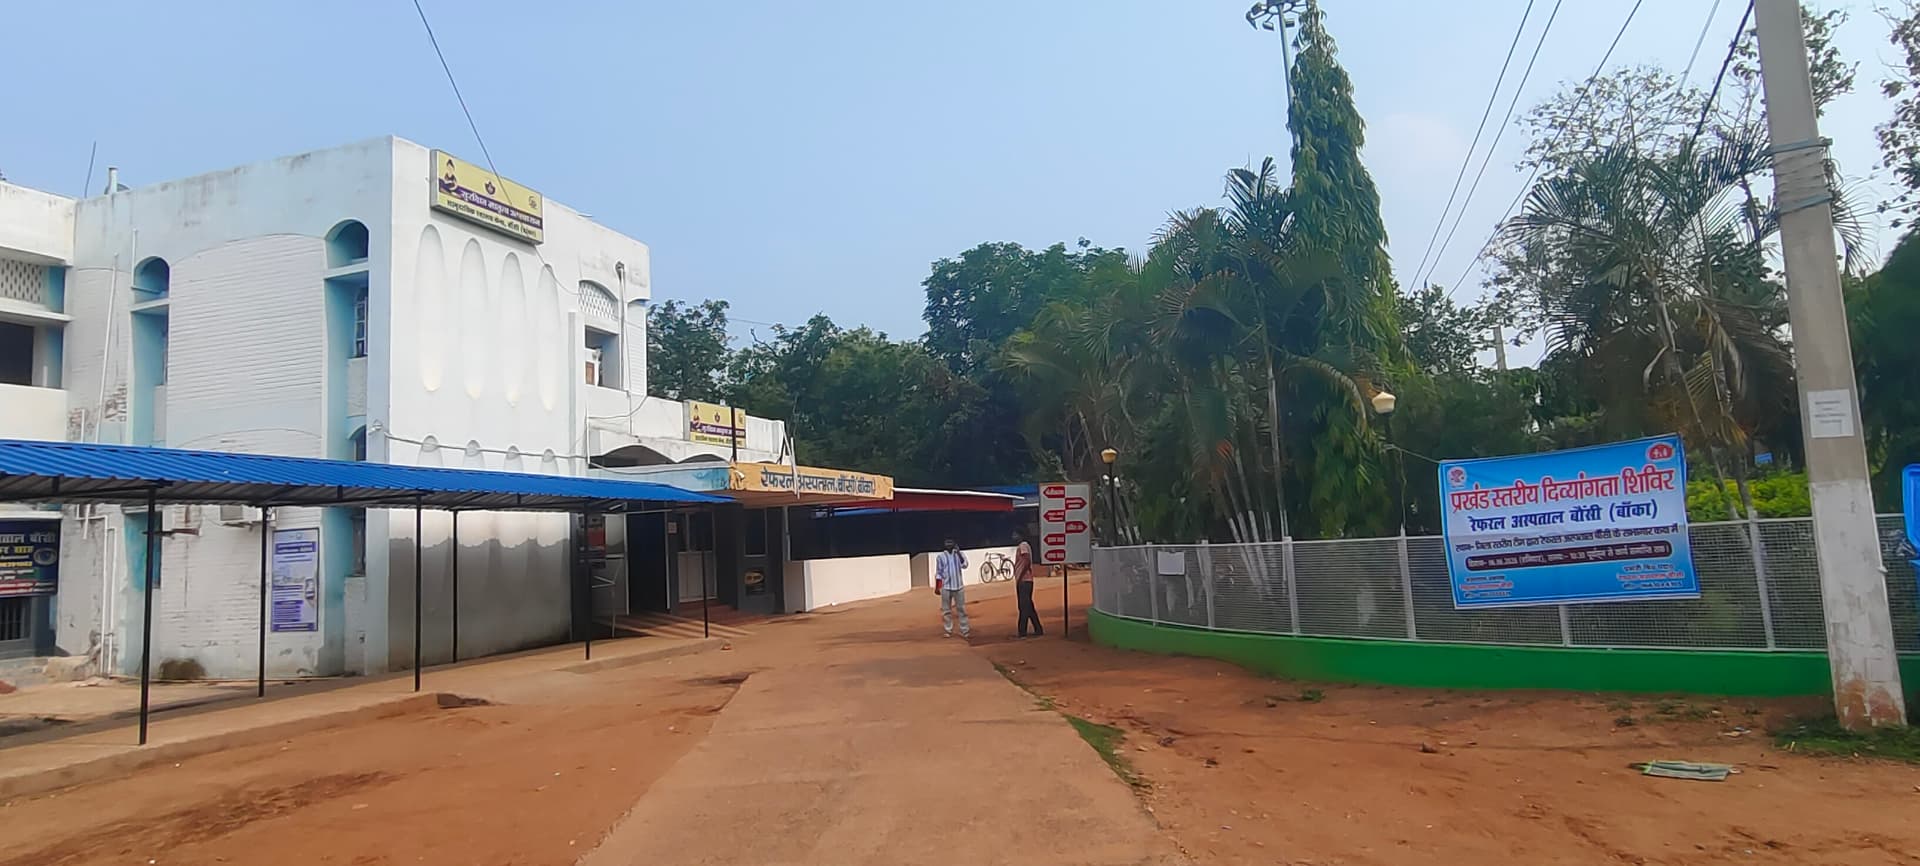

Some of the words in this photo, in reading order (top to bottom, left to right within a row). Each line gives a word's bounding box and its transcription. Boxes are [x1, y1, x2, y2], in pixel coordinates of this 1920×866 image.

[761, 465, 794, 488] रेफरल
[1450, 483, 1490, 513] प्रखंड
[1492, 479, 1540, 507] स्तरीय
[1542, 472, 1619, 504] दिव्यांगता
[1622, 464, 1674, 495] शिविर
[1467, 515, 1506, 531] रेफरल
[1511, 510, 1565, 528] अस्पताल
[1569, 504, 1602, 522] बौंसी
